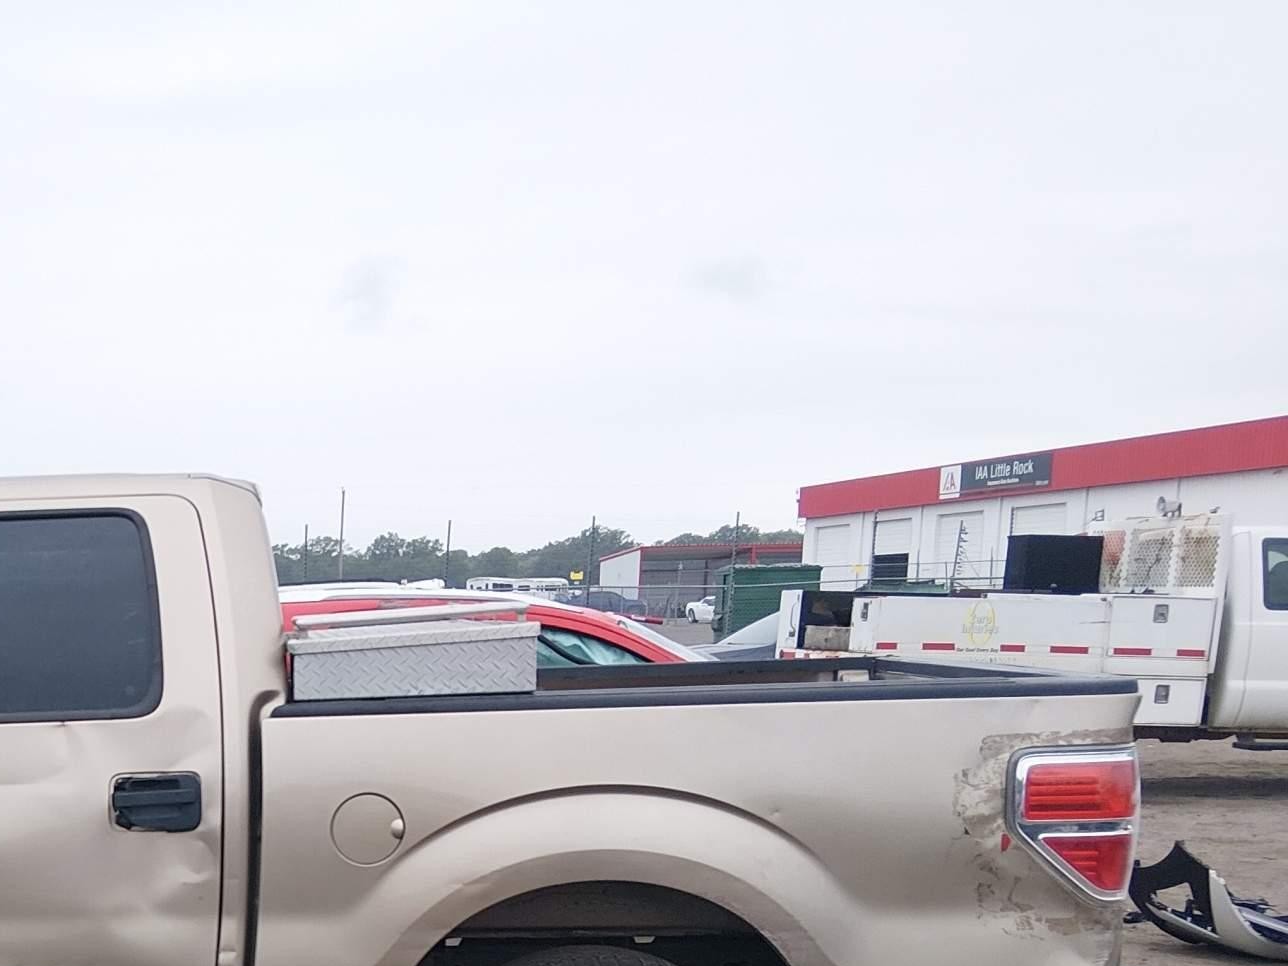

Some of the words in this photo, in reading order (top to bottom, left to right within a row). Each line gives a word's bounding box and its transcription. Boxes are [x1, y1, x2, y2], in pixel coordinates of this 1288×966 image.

[975, 465, 989, 481] IAA
[990, 462, 1011, 478] Little
[1012, 459, 1034, 475] Rock
